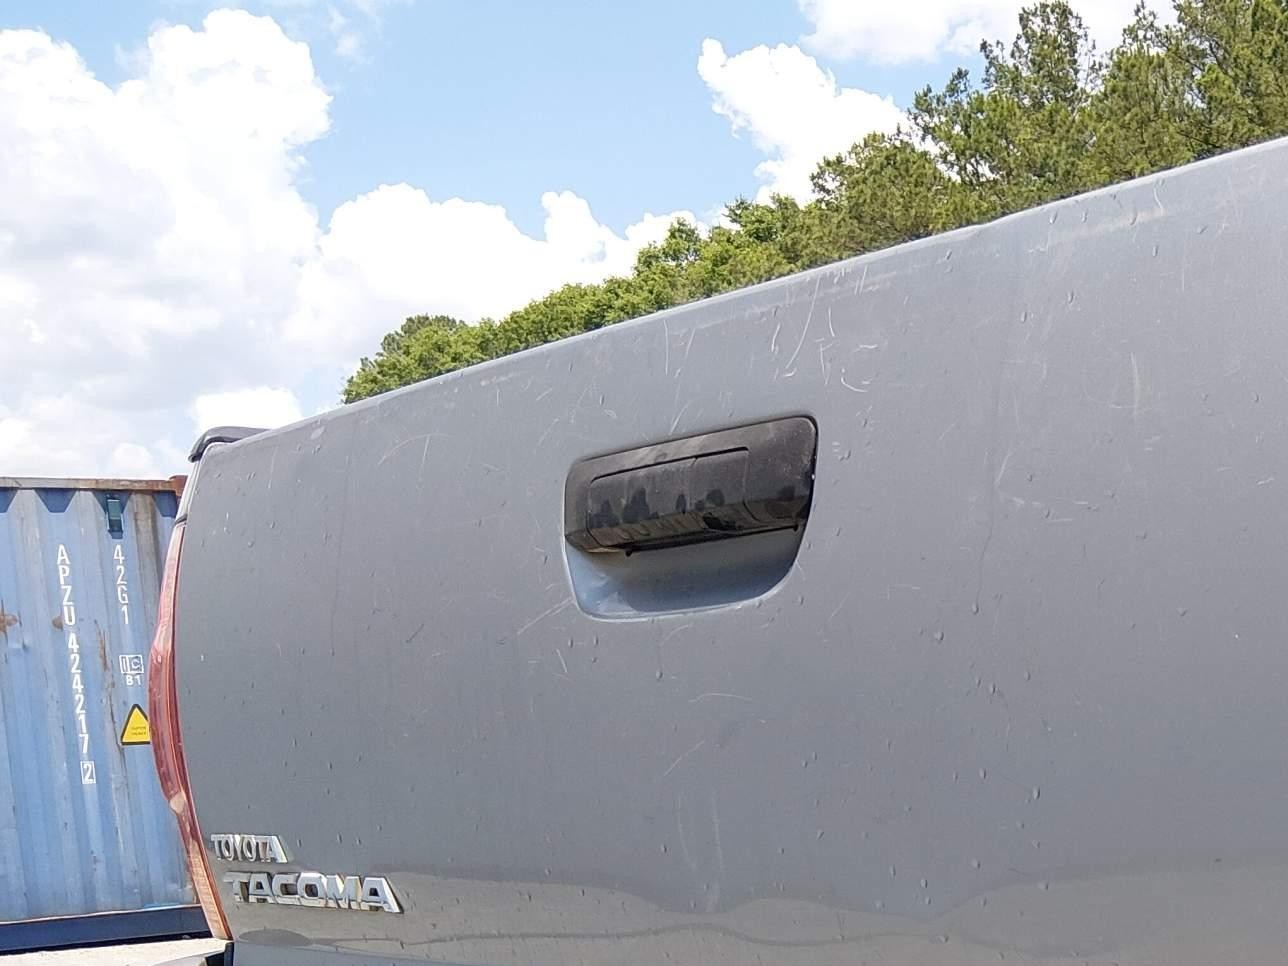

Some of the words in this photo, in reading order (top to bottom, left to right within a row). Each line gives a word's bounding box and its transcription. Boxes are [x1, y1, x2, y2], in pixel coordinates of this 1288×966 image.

[113, 543, 129, 625] 42G1
[56, 543, 76, 626] APZU
[67, 632, 89, 754] 424217
[211, 833, 288, 863] TOYOTA
[224, 871, 404, 914] TACOMA
